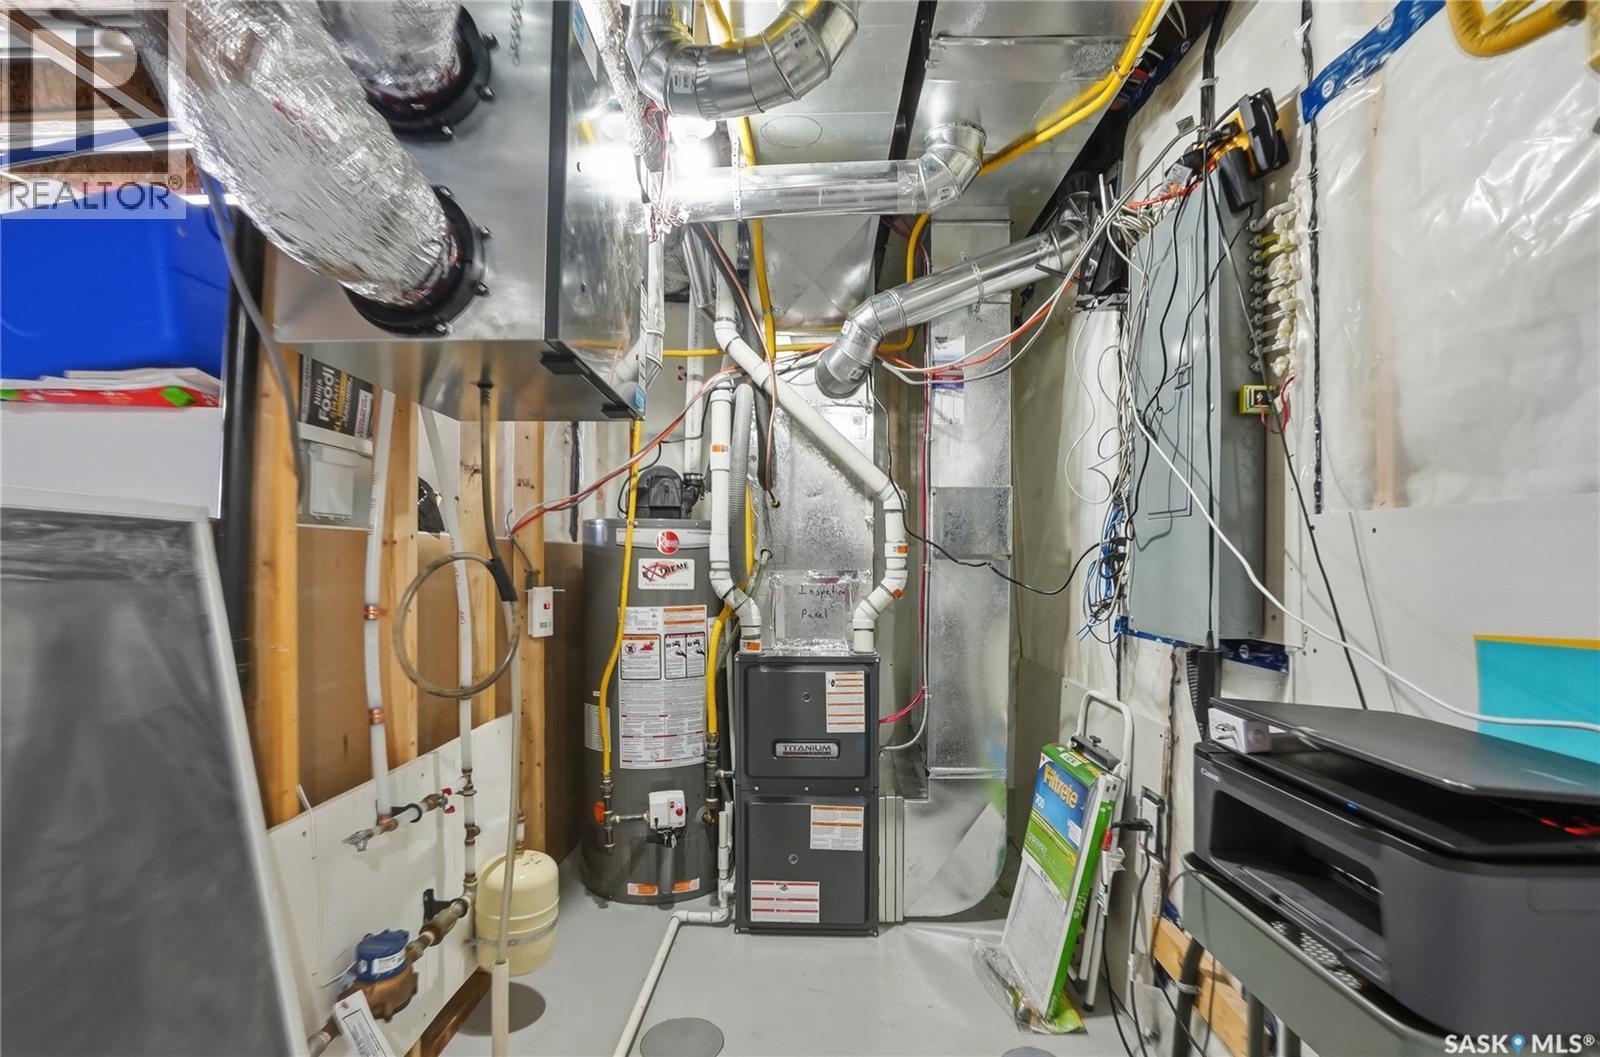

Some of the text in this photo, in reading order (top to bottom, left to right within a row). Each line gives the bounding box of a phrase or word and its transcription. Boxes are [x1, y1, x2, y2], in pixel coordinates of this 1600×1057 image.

[801, 608, 828, 620] Panel
[783, 744, 831, 752] TITANIUM
[1043, 764, 1079, 809] Filtrete
